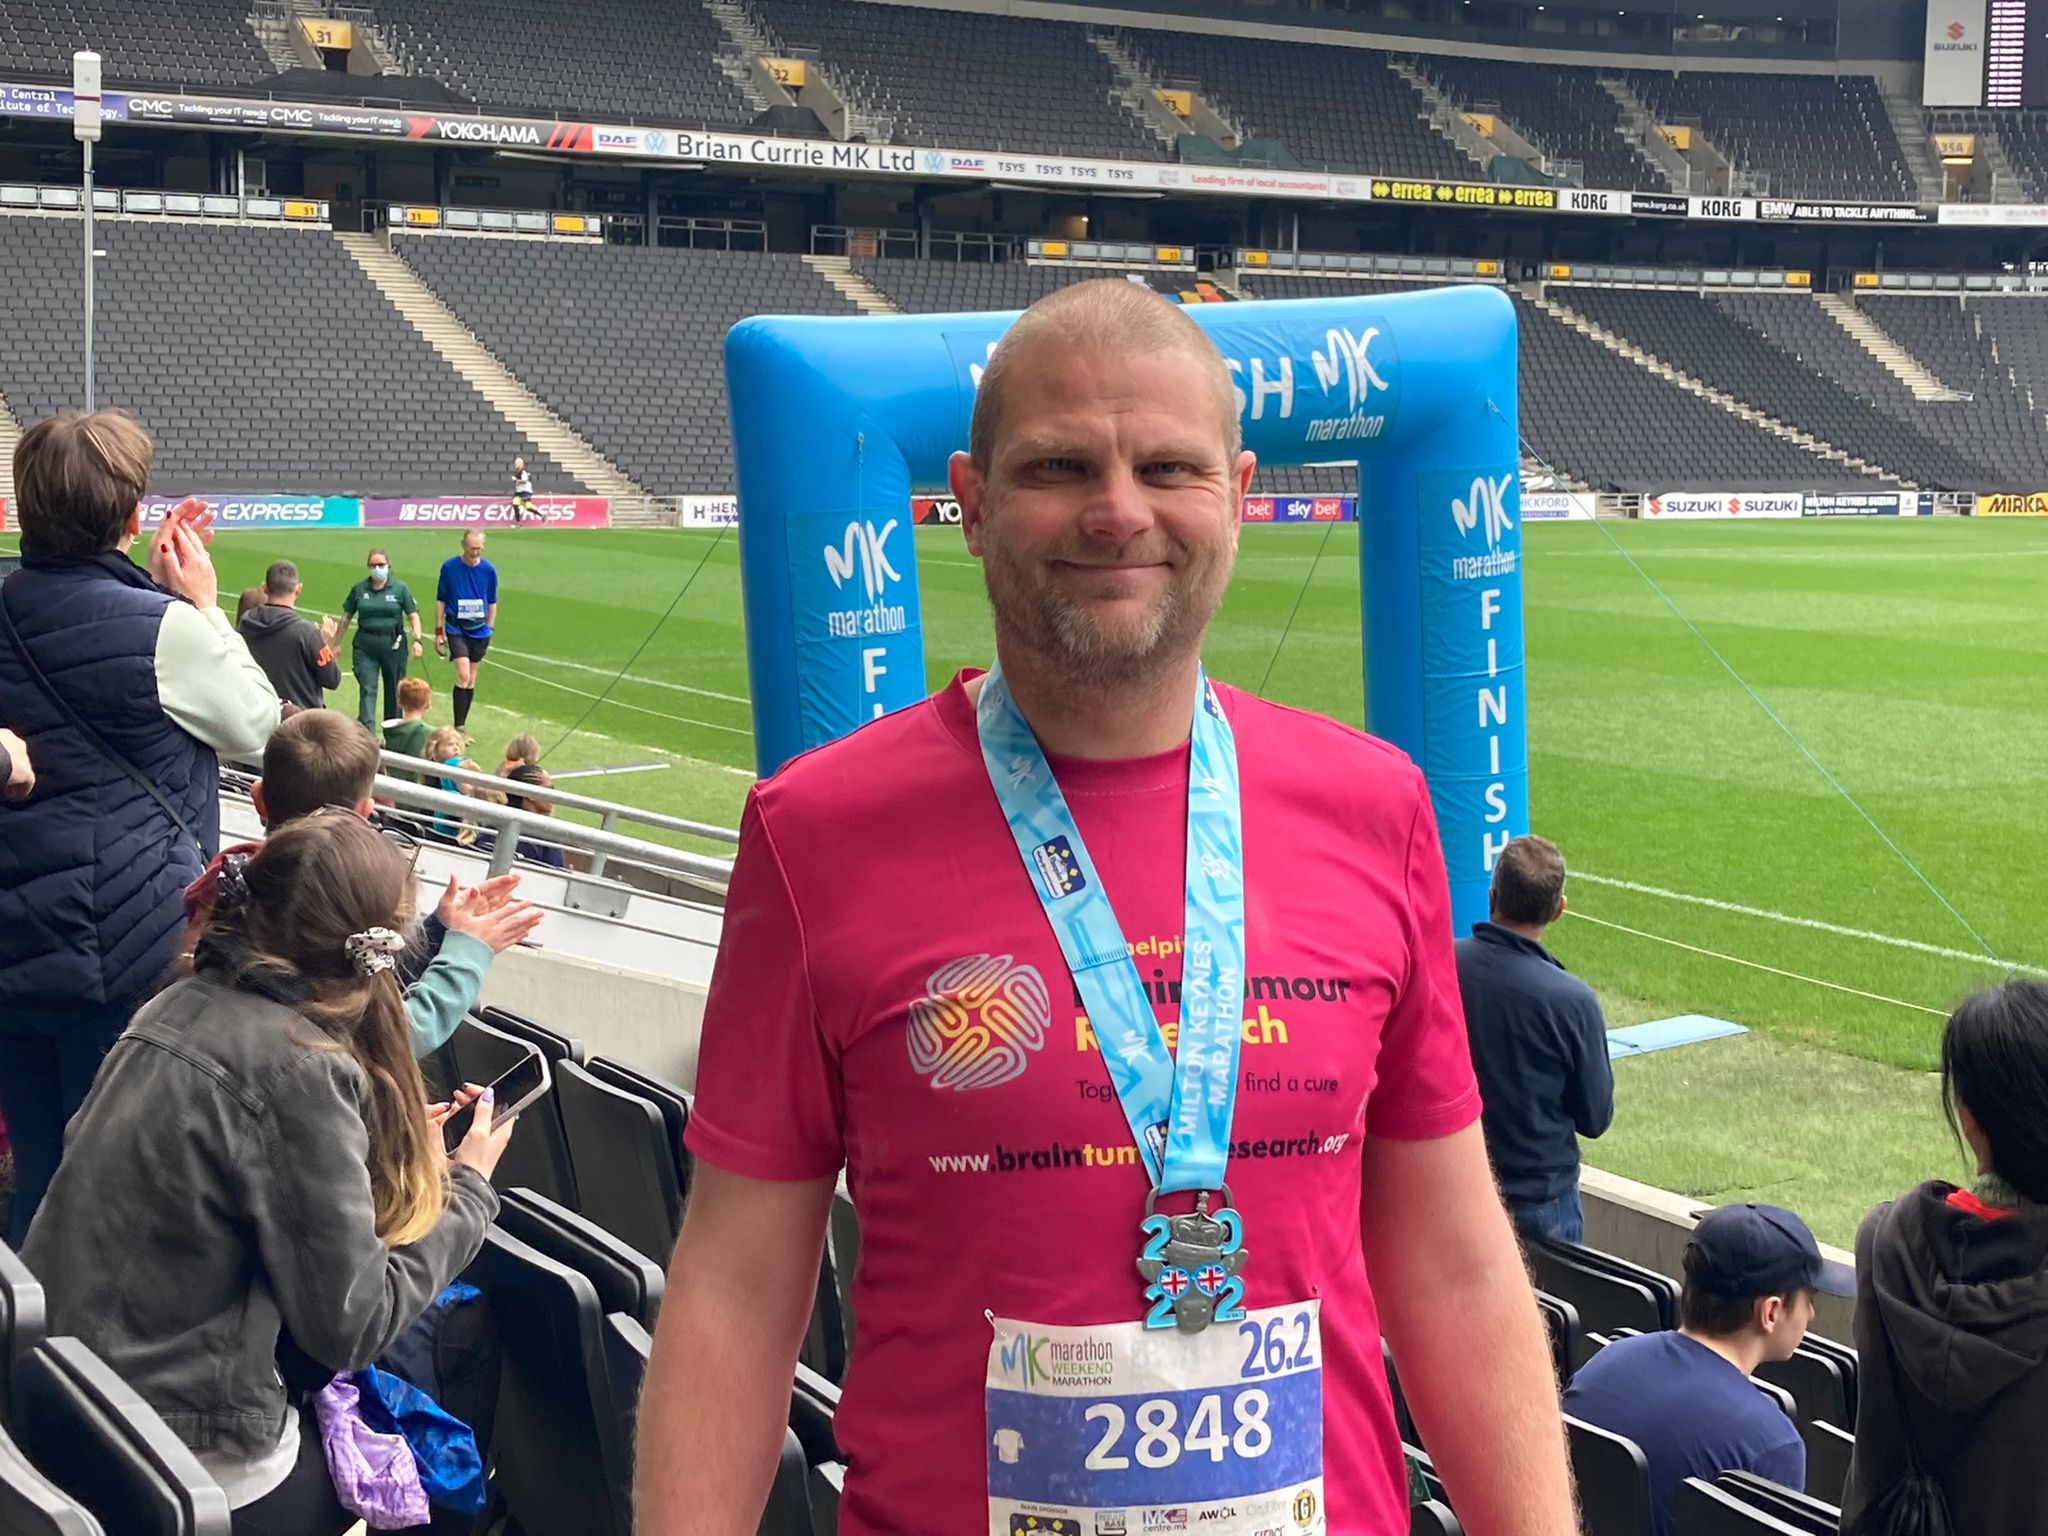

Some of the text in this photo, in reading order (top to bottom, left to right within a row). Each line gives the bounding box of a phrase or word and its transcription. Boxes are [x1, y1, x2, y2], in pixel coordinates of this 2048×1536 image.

[316, 30, 332, 44] 31
[1933, 43, 1978, 51] SUZUKI
[11, 89, 56, 101] Central
[37, 103, 49, 113] of
[128, 99, 173, 114] CMC
[179, 103, 213, 115] Tackling
[213, 107, 233, 116] your
[242, 109, 268, 117] needs
[270, 107, 313, 122] CMC
[318, 112, 351, 124] Tackling
[352, 116, 370, 125] your
[437, 120, 540, 145] YOKOHAMA
[677, 133, 916, 171] Brian Currie MK Ltd
[998, 162, 1134, 180] TSYS TSYS TSYS TSYS
[1192, 173, 1226, 187] Leading
[1227, 176, 1245, 185] firm
[1246, 177, 1255, 186] of
[1256, 178, 1277, 188] local
[1278, 182, 1328, 191] accountants
[1391, 182, 1433, 201] errea
[1454, 186, 1495, 204] errea
[1513, 189, 1554, 207] errea
[1571, 192, 1608, 210] KORG
[1632, 200, 1687, 212] www.korg.co.uk
[1701, 200, 1741, 218] KORG
[1761, 201, 1795, 215] EMW
[303, 206, 315, 216] 31
[410, 211, 421, 221] 31
[1794, 206, 1820, 217] ABLE
[1820, 206, 1834, 218] TO
[1834, 207, 1869, 219] TACKLE
[1869, 207, 1927, 220] ANYTHING...
[1305, 407, 1384, 442] marathon
[1247, 502, 1270, 516] bet
[1287, 500, 1338, 519] sky bet
[1666, 500, 1722, 512] SUZUKI
[1744, 500, 1798, 512] SUZUKI
[1836, 496, 1867, 506] KEYNES
[222, 502, 324, 521] EXPRESS
[416, 503, 575, 521] SIGNS EXPRESS
[1453, 545, 1515, 580] marathon
[828, 598, 905, 637] marathon
[1178, 940, 1212, 1136] MILTON KEYNES
[1207, 966, 1237, 1106] MARATHON
[1245, 1072, 1281, 1092] find
[1287, 1077, 1298, 1092] a
[1304, 1077, 1338, 1092] cure
[1050, 1336, 1113, 1361] marathon
[1239, 1311, 1314, 1379] 26.2
[1000, 1332, 1050, 1389] MK
[1051, 1360, 1114, 1375] WEEKEND
[1051, 1375, 1113, 1387] MARATHON
[1085, 1388, 1272, 1471] 2848
[1039, 1506, 1068, 1514] SPONSOR
